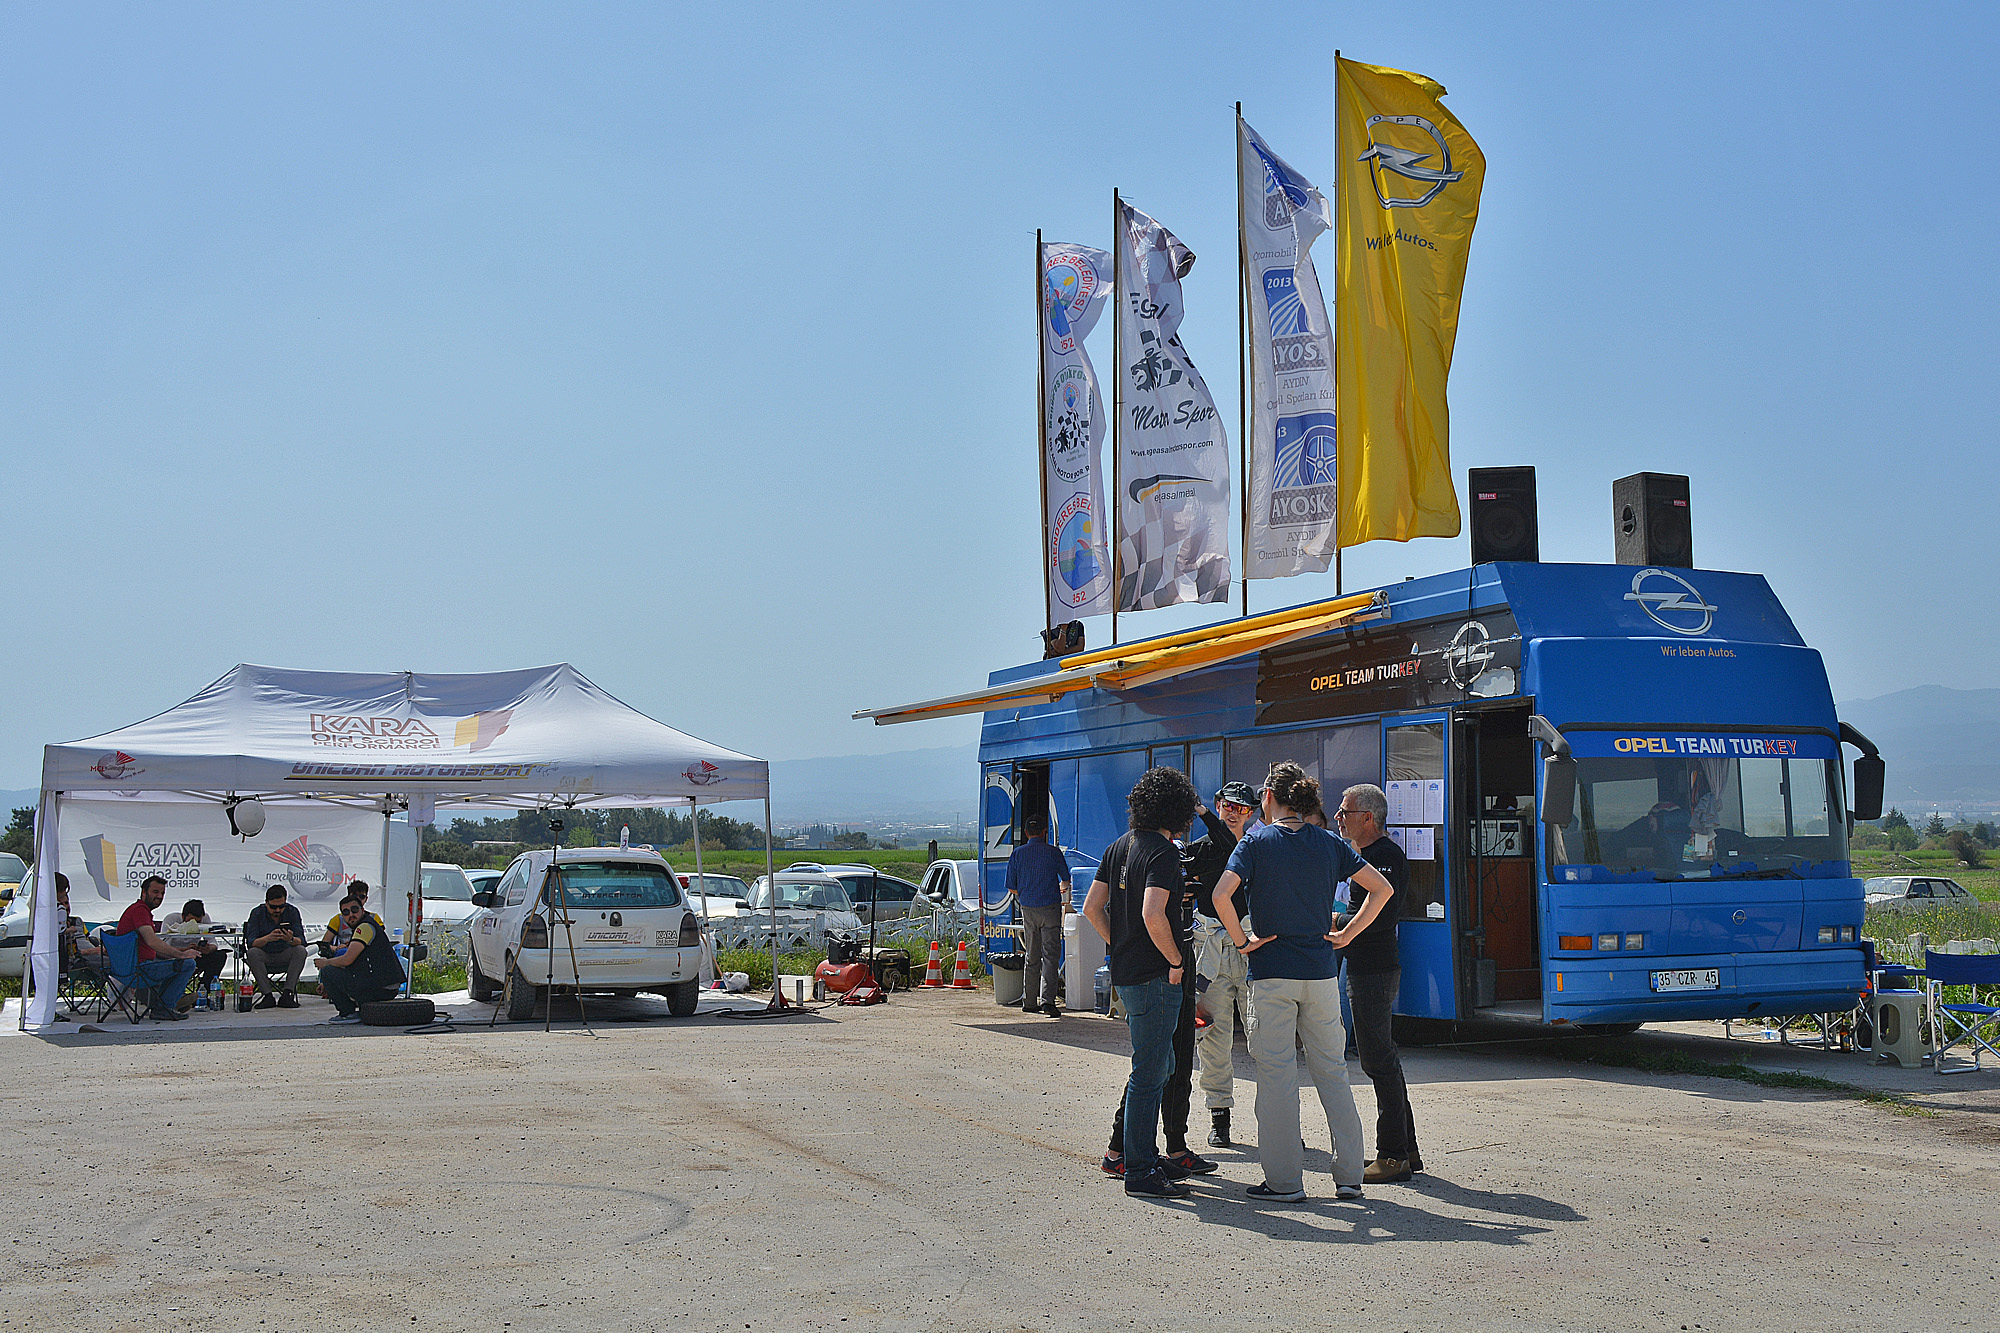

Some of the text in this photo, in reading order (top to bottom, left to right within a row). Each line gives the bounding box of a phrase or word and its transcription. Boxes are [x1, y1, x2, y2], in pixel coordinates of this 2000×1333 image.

[1373, 115, 1435, 134] OPEL
[1395, 228, 1438, 252] Autos.
[1267, 276, 1292, 289] 2013
[1273, 342, 1324, 366] YOS
[1173, 400, 1215, 430] Spor
[1271, 493, 1329, 519] AYOSK
[1661, 646, 1737, 658] Wir leben Autos.
[1310, 659, 1422, 692] OPEL TEAM TURKEY
[310, 713, 439, 737] KARA
[311, 733, 440, 745] Old School
[314, 741, 442, 750] PERFORMANCE
[1614, 737, 1798, 755] OPEL TEAM TURKEY
[392, 763, 537, 777] MOTORSPORT
[656, 930, 678, 940] KARA
[985, 920, 1006, 939] eben
[1659, 973, 1671, 986] 35
[1678, 972, 1696, 985] CZR
[1705, 971, 1717, 984] 45
